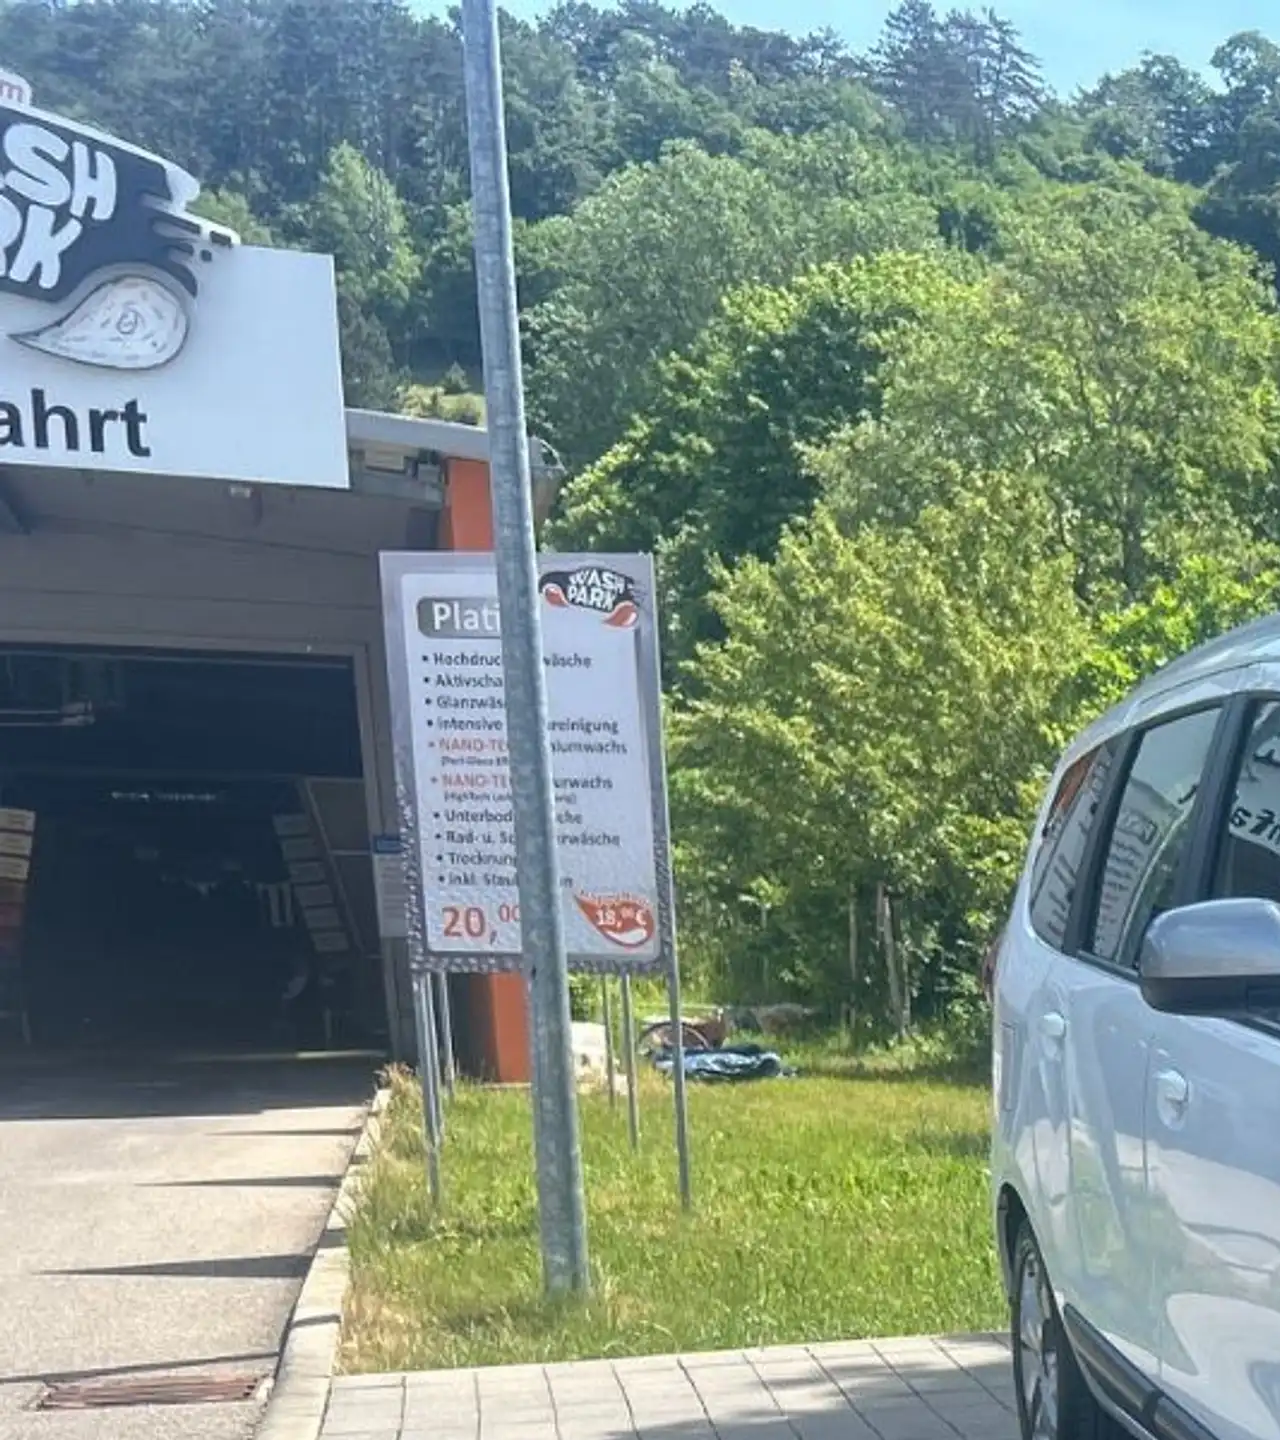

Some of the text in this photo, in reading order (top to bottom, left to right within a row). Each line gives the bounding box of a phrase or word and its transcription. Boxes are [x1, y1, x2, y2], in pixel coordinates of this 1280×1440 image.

[0, 122, 117, 222] SH
[0, 387, 153, 458] ahrt
[568, 568, 626, 595] WASH
